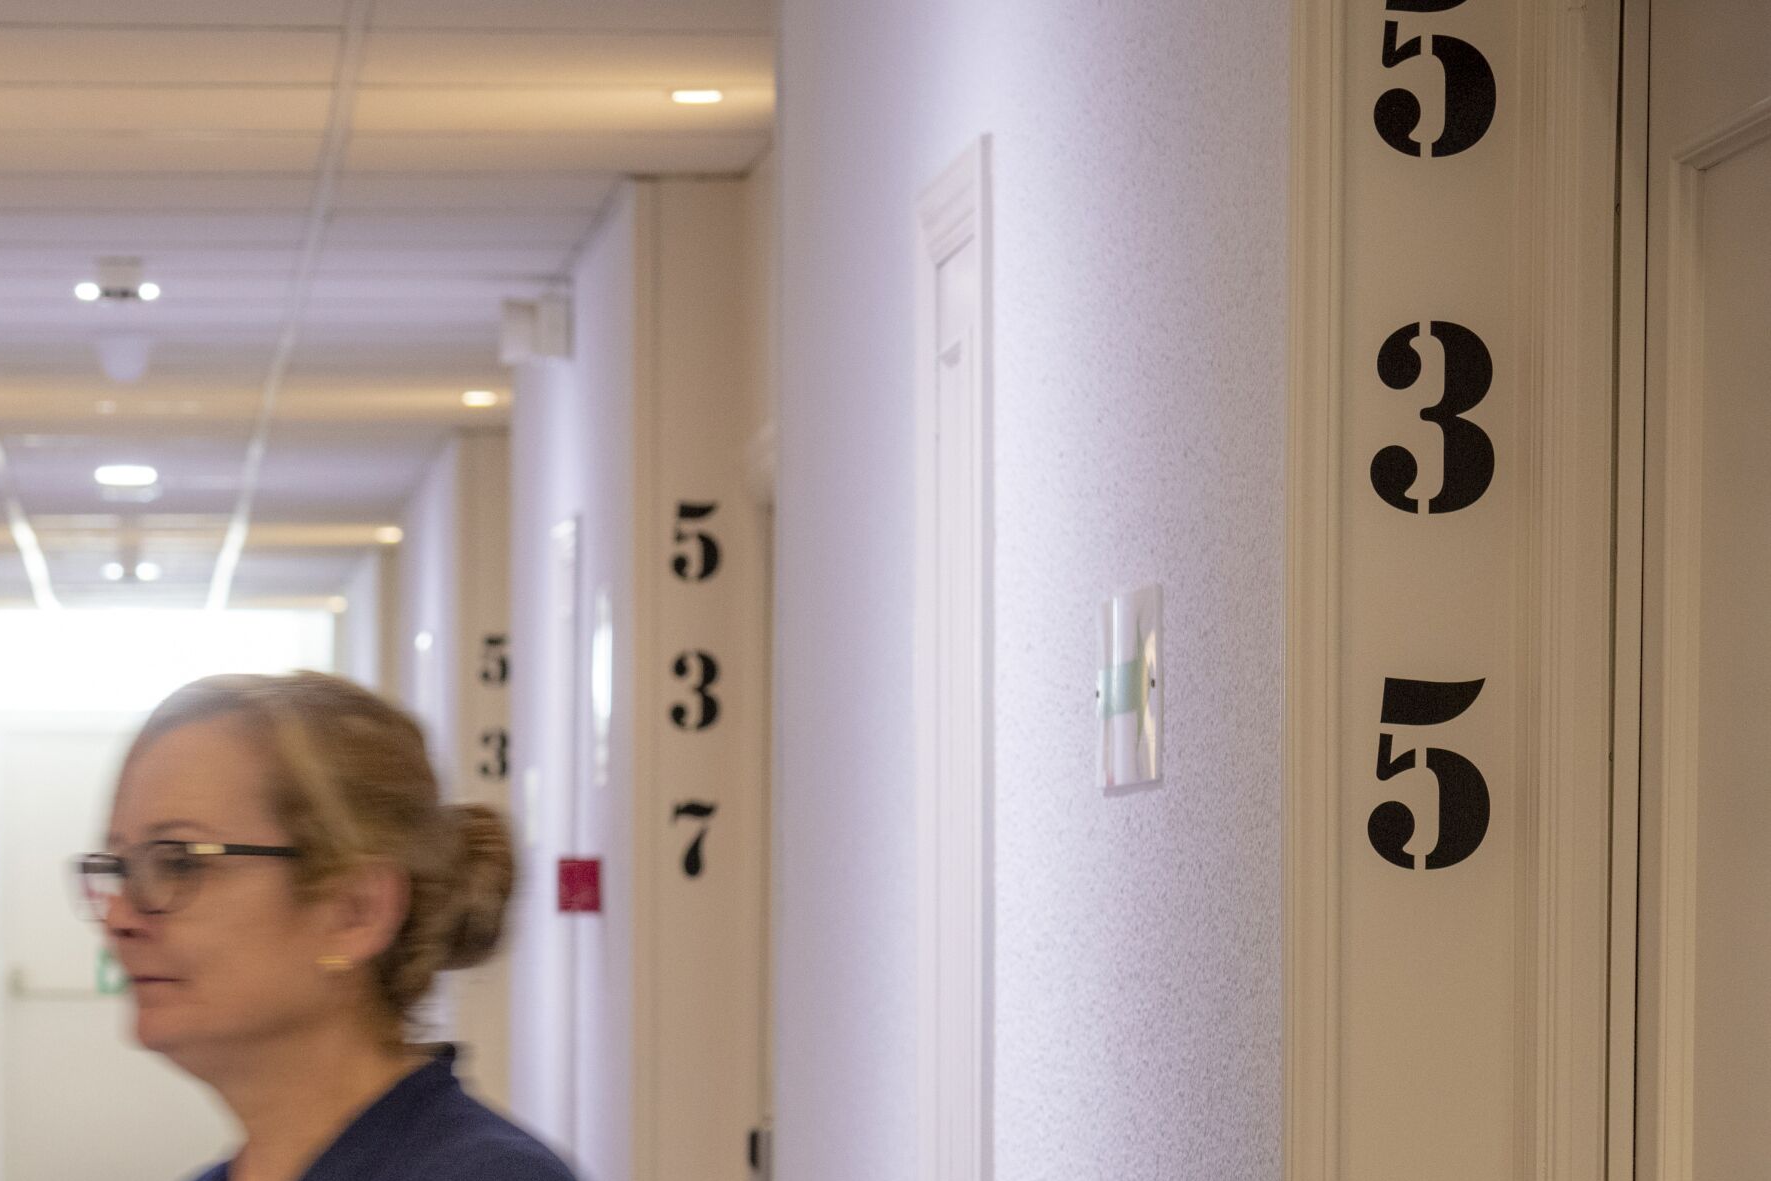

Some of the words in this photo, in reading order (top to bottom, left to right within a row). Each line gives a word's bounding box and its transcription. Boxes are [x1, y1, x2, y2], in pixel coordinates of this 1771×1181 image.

[1366, 0, 1497, 870] 535
[480, 634, 510, 780] 53
[670, 500, 722, 878] 537
